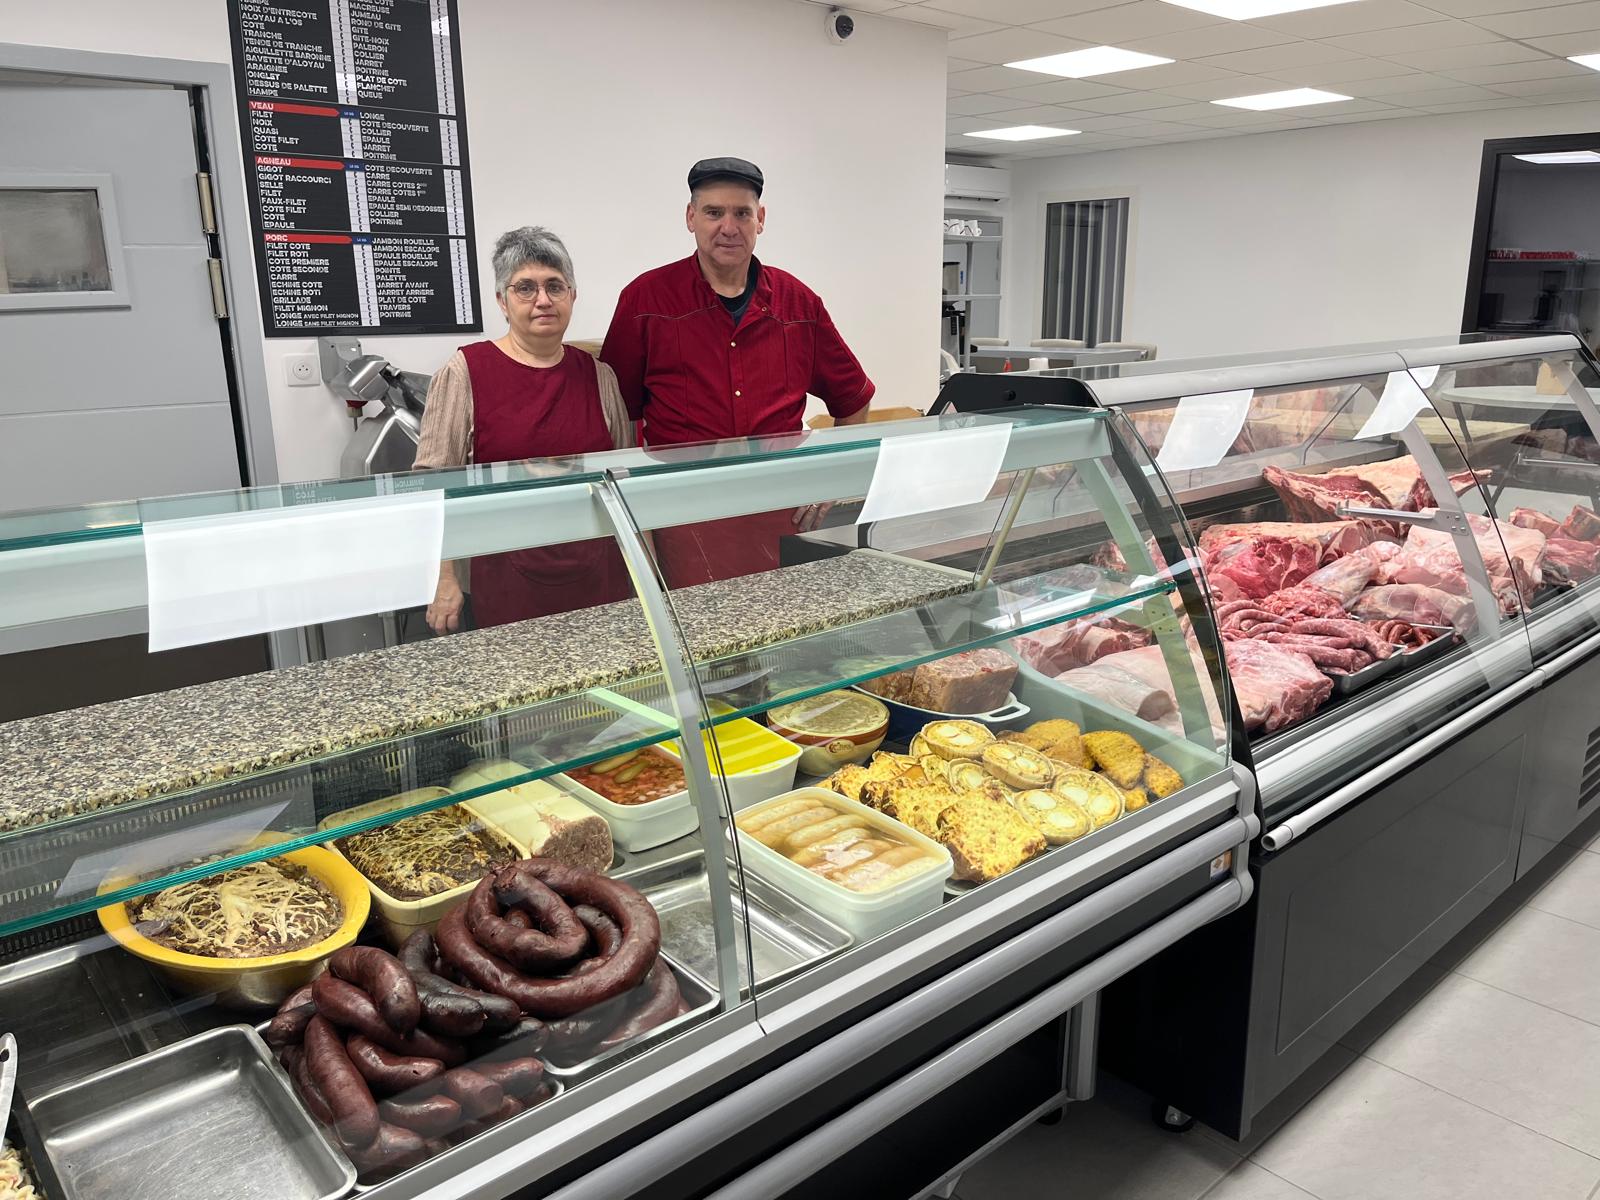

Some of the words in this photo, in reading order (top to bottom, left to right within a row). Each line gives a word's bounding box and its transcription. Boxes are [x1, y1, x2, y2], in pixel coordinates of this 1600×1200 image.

[240, 4, 261, 13] NOIX
[262, 7, 317, 20] D'ENTRECOTE
[351, 10, 381, 20] JUMEAU
[242, 12, 276, 22] ALOYAU
[242, 21, 265, 30] COTE
[351, 18, 372, 27] ROND
[385, 23, 401, 31] GITE
[243, 29, 282, 40] TRANCHE
[352, 26, 368, 34] GITE
[244, 38, 271, 47] TENDE
[284, 42, 323, 53] TRANCHE
[353, 43, 388, 53] PALERON
[245, 46, 294, 57] AIGUILLETTE
[295, 51, 331, 62] BARONNE
[354, 50, 385, 60] COLLIER
[246, 54, 283, 65] BAVETTE
[285, 59, 324, 69] D'ALOYAU
[355, 58, 383, 68] JARRET
[247, 71, 280, 80] ONGLET
[355, 66, 389, 76] POITRINE
[356, 74, 375, 82] PLAT
[387, 78, 407, 87] COTE
[248, 80, 280, 88] DESSUS
[294, 84, 328, 93] PALETTE
[249, 88, 278, 96] HAMPE
[357, 90, 383, 99] QUEUE
[250, 102, 274, 110] VEAU
[360, 112, 385, 120] LONGE
[252, 118, 273, 126] NOIX
[253, 127, 278, 135] QUASI
[382, 122, 429, 133] DECOUVERTE
[361, 128, 392, 137] COLLIER
[362, 136, 391, 144] EPAULE
[255, 143, 278, 152] COTE
[363, 143, 391, 152] JARRET
[364, 151, 397, 160] POITRINE
[257, 157, 291, 166] AGNEAU
[386, 166, 433, 176] DECOUVERTE
[285, 175, 332, 184] RACCOURCI
[261, 197, 307, 206] FAUX-FILET
